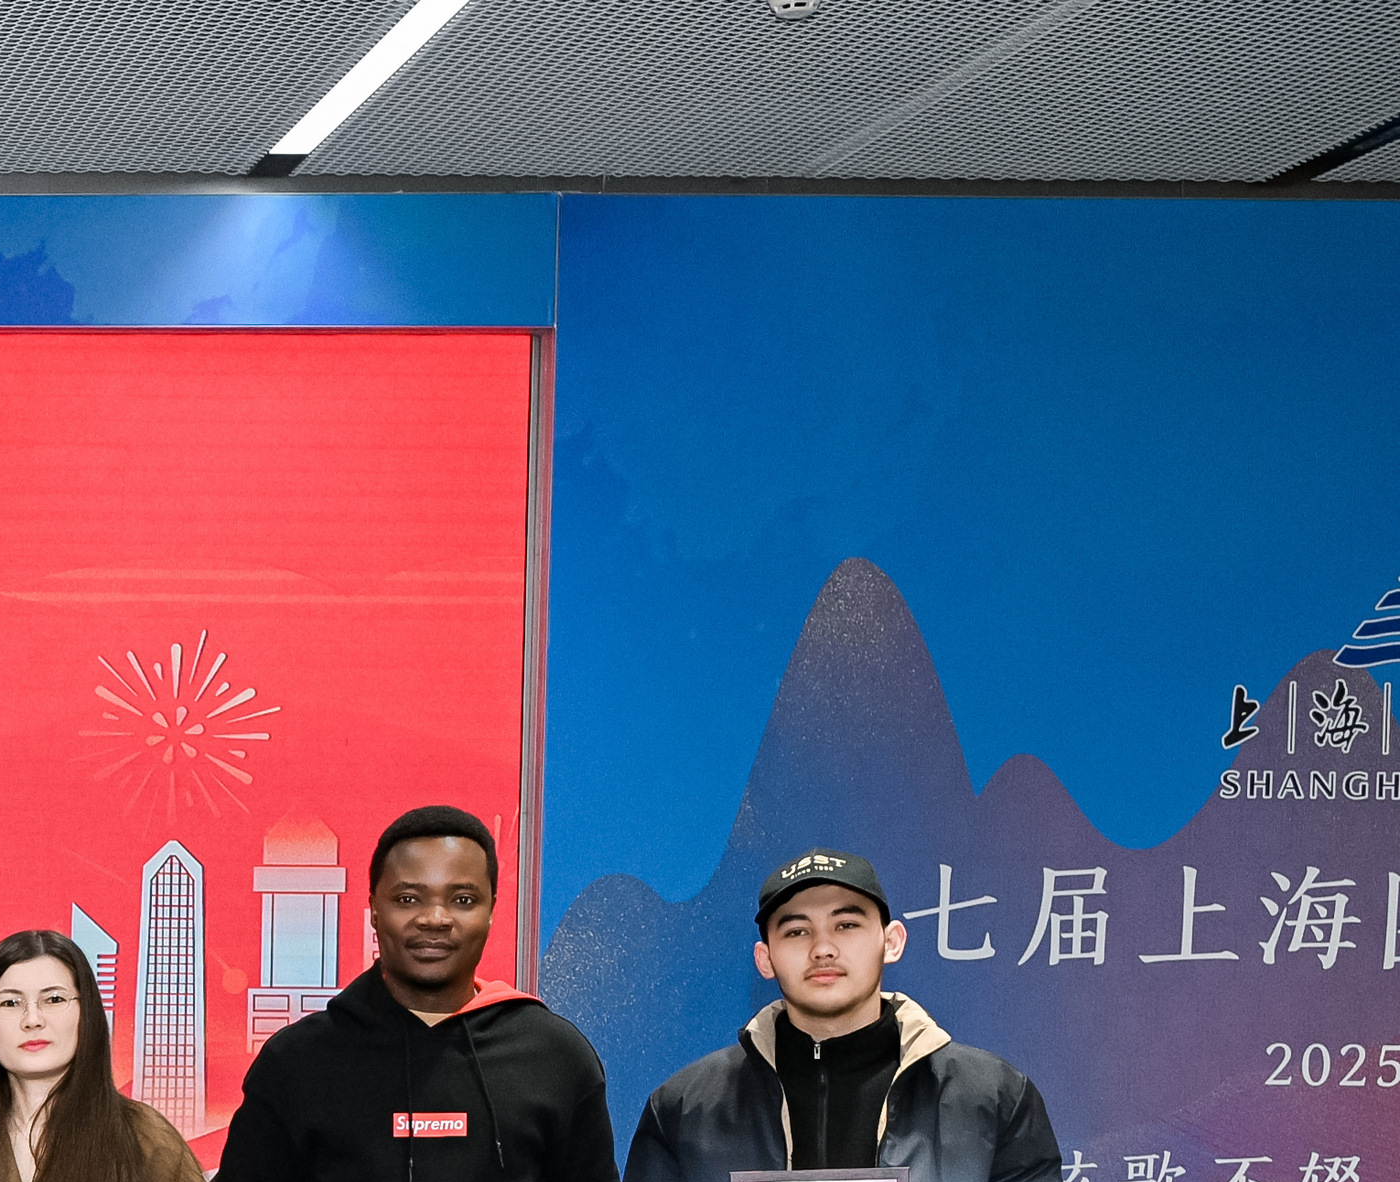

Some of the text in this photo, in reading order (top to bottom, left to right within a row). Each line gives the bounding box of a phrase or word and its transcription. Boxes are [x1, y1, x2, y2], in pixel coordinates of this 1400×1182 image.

[902, 864, 1400, 970] 七届上海
[1264, 1043, 1400, 1088] 2025
